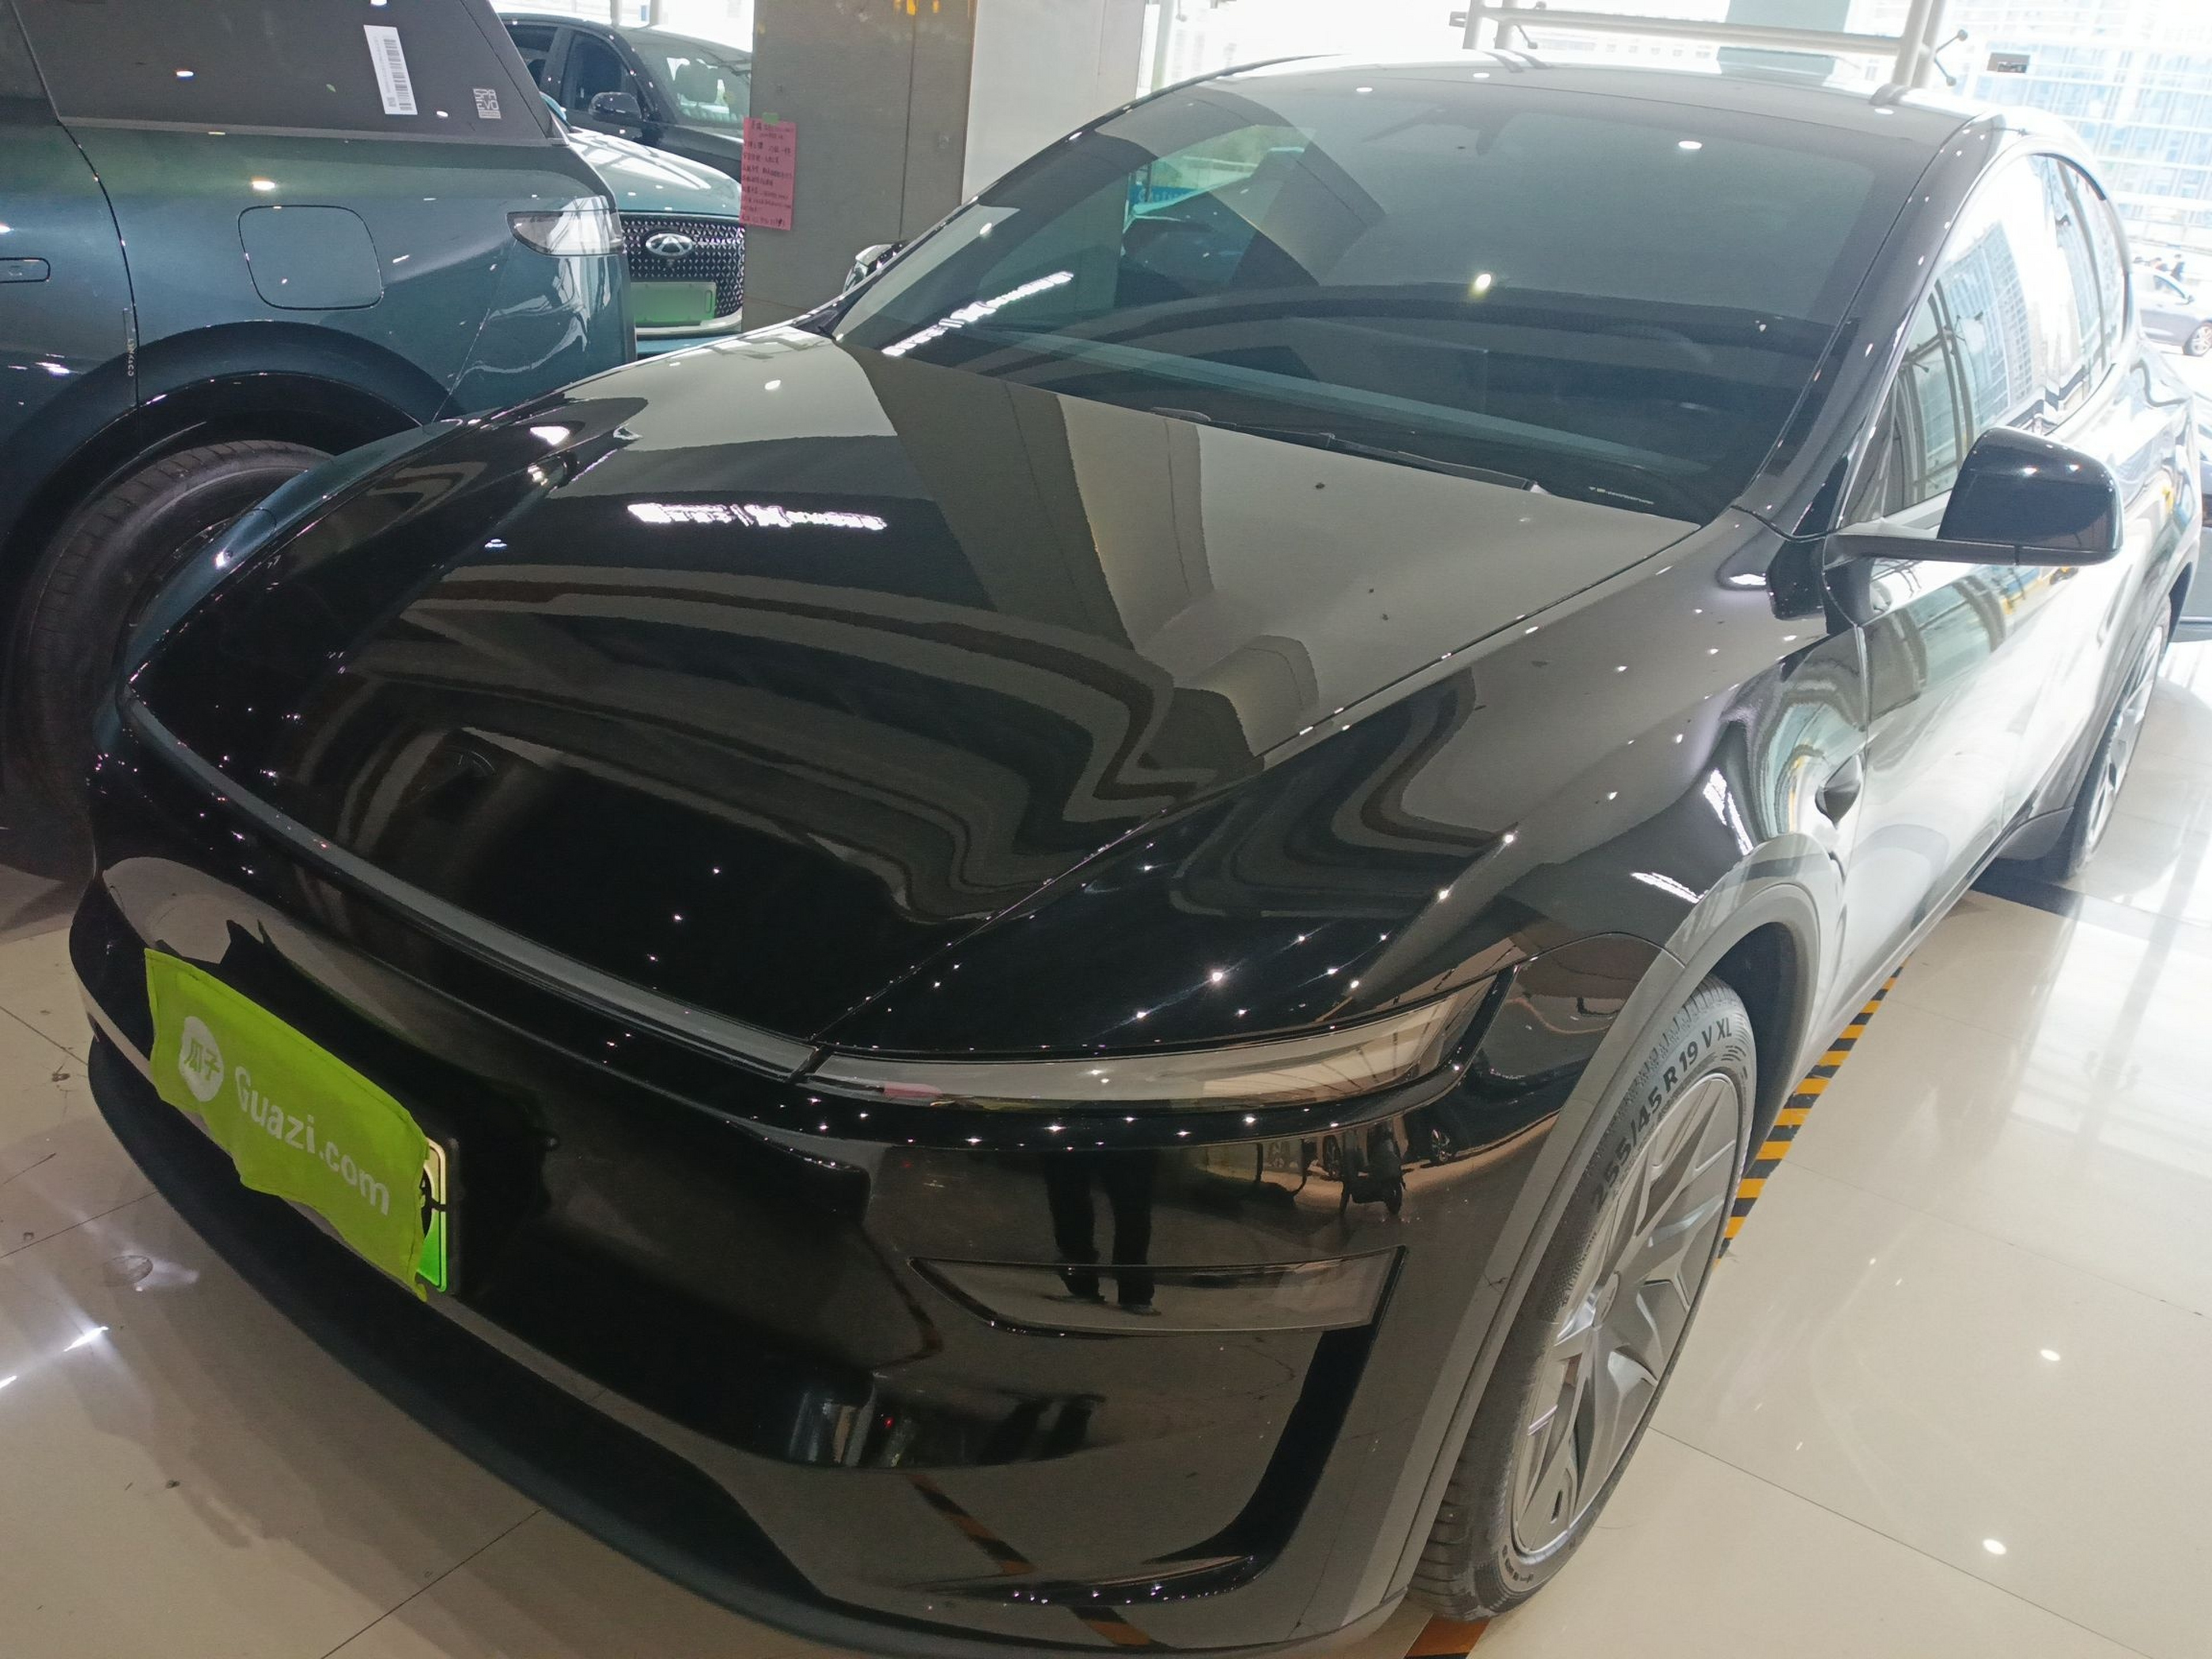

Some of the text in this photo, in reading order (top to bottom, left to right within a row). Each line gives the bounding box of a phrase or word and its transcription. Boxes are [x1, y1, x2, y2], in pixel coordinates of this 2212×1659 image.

[476, 99, 499, 110] EVO
[184, 1037, 221, 1082] 瓜子
[1663, 1066, 1678, 1093] R
[1679, 1041, 1698, 1072] 19
[1702, 1030, 1712, 1048] V
[1717, 1017, 1732, 1041] XL
[235, 1066, 391, 1216] Guazi.com
